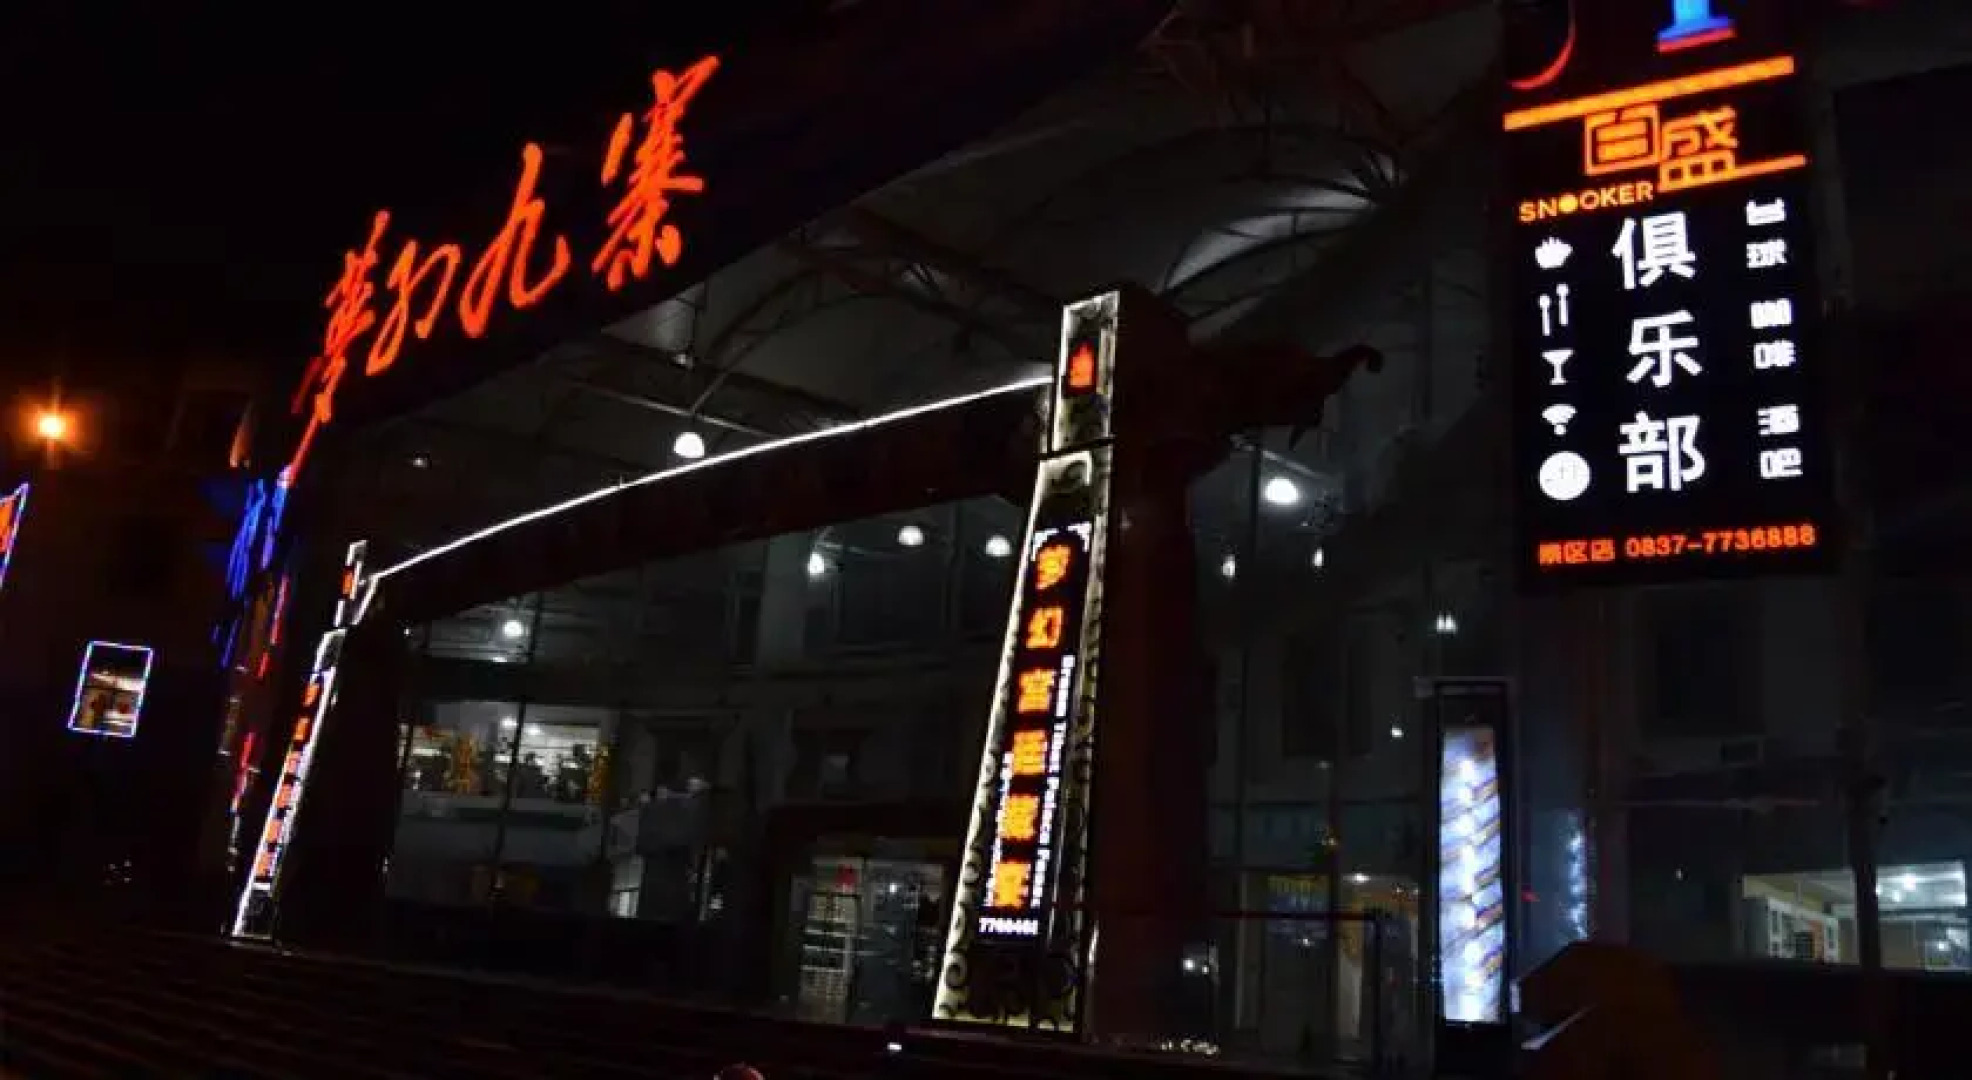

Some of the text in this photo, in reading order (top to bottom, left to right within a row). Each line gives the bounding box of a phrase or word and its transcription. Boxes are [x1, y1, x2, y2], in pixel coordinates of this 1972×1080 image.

[1584, 103, 1738, 192] 百盛
[1518, 180, 1655, 223] SNOOKER
[1611, 211, 1706, 494] 俱乐部
